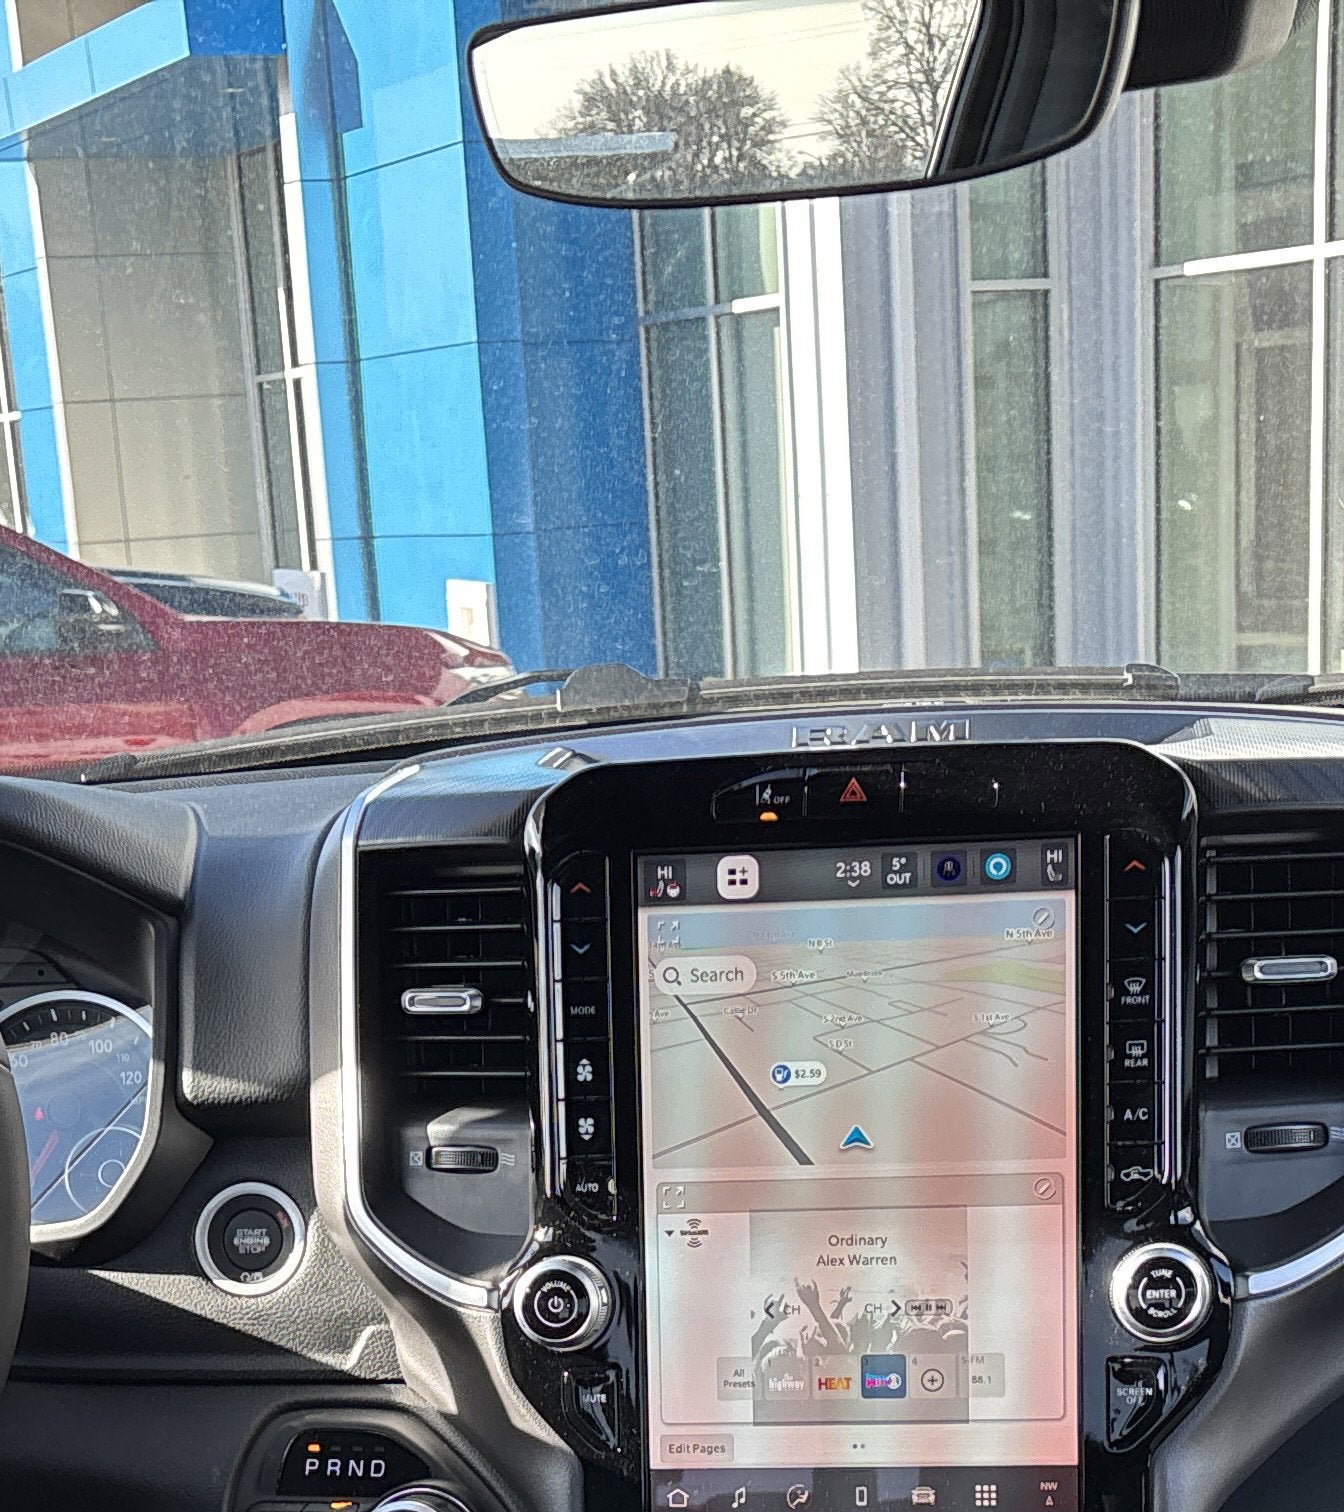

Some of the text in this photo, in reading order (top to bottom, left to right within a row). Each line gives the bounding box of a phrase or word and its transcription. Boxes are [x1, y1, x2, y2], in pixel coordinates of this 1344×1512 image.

[791, 719, 970, 748] RAM
[1047, 849, 1063, 863] HI
[657, 866, 673, 879] HI
[836, 861, 871, 878] 2:38
[886, 873, 911, 885] OUT
[1016, 929, 1032, 938] 5th
[1034, 929, 1052, 938] Ave
[690, 967, 744, 982] Search
[798, 971, 815, 979] Ave
[1120, 994, 1151, 1005] FRONT
[570, 1006, 596, 1015] MODE
[50, 1032, 69, 1046] 80
[88, 1040, 113, 1053] 100
[116, 1053, 130, 1063] 110
[1124, 1058, 1148, 1067] REAR
[120, 1072, 142, 1085] 120
[794, 1069, 822, 1080] $2.59
[1124, 1108, 1148, 1121] A/C
[576, 1183, 599, 1192] AUTO
[236, 1228, 267, 1236] START
[234, 1236, 270, 1246] ENGINE
[828, 1234, 888, 1249] Ordinary
[239, 1245, 265, 1254] STOP
[816, 1254, 897, 1267] Alex Warren
[1150, 1268, 1174, 1279] TUNE
[540, 1280, 571, 1292] VOLUME
[1146, 1289, 1177, 1299] ENTER
[784, 1305, 801, 1315] CH
[864, 1303, 882, 1314] CH
[1147, 1308, 1178, 1318] SCROLL
[733, 1369, 745, 1377] All
[723, 1379, 755, 1388] Presets
[768, 1377, 804, 1391] highway
[818, 1377, 852, 1390] HEAT
[1116, 1387, 1153, 1396] SCREEN
[583, 1393, 607, 1403] MUTE
[668, 1444, 726, 1455] Edit Pages
[305, 1458, 386, 1478] P R N D
[1040, 1481, 1058, 1490] NW
